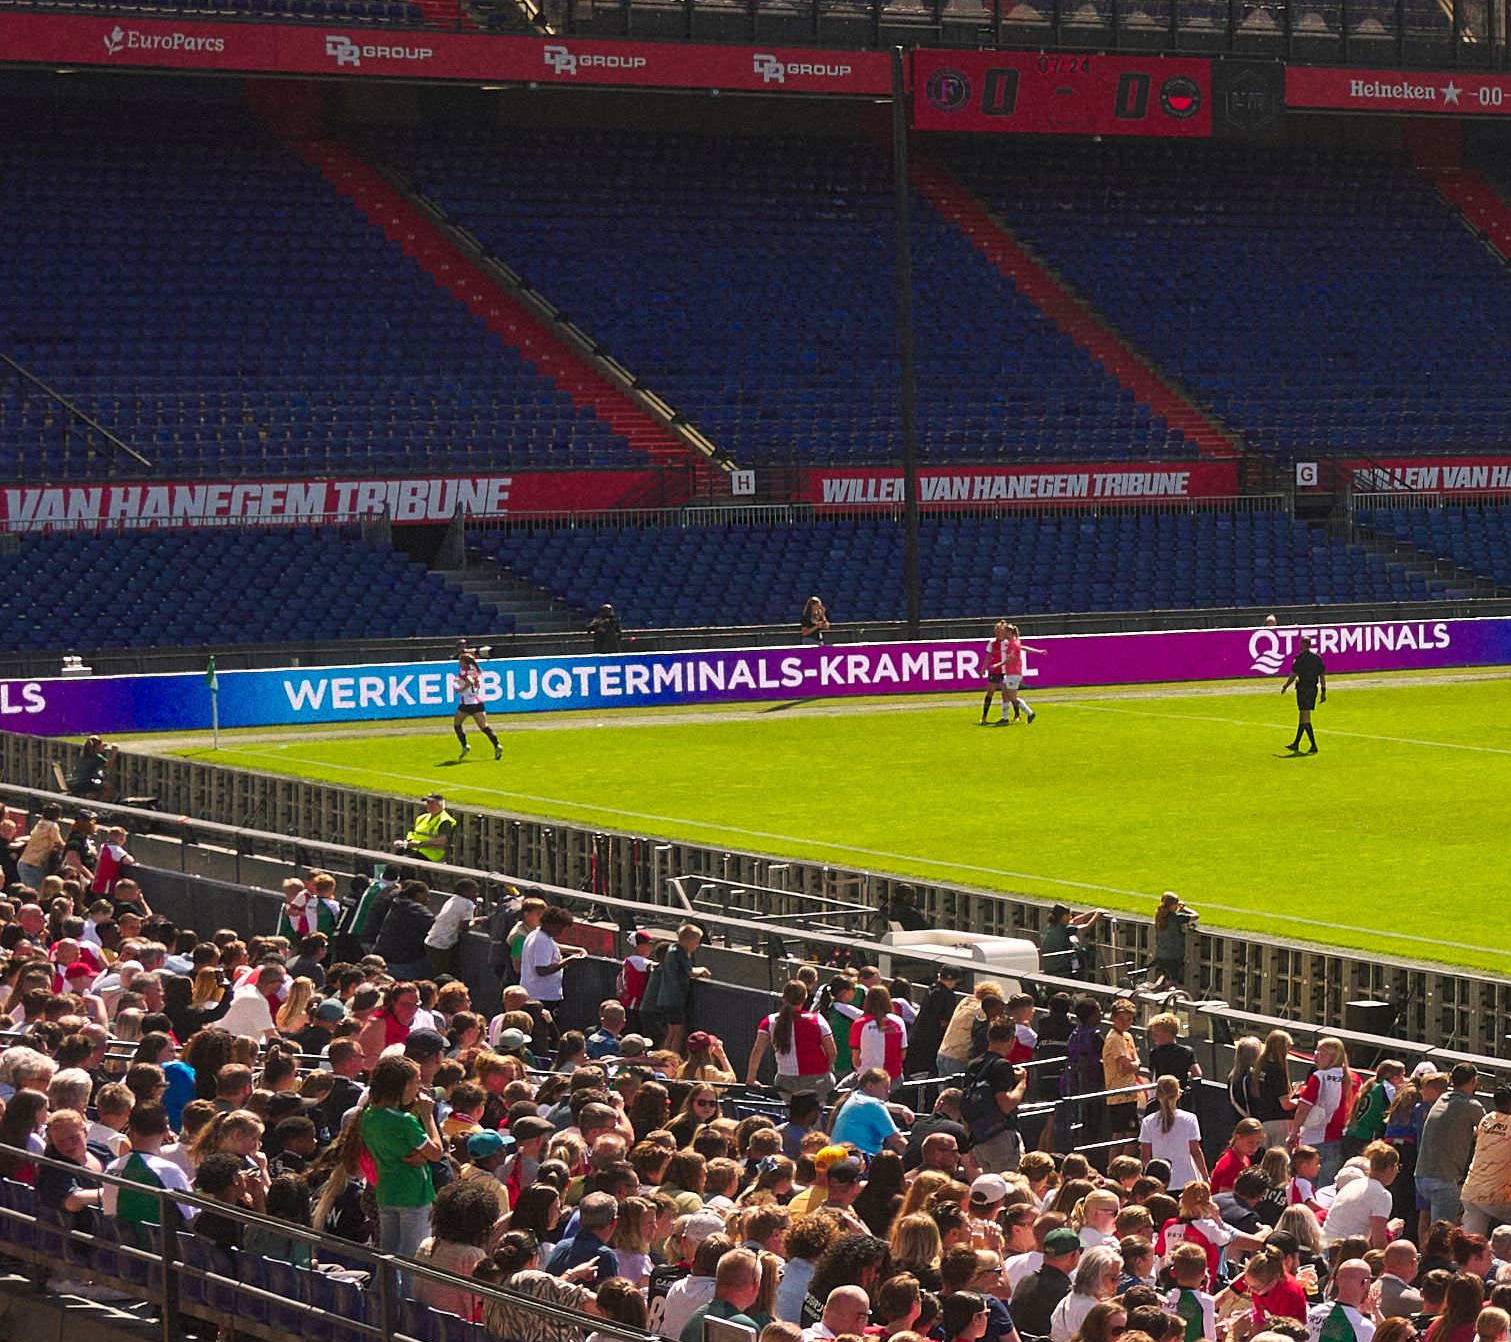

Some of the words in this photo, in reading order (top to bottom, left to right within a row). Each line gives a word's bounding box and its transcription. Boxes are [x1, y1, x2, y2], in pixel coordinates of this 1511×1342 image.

[127, 31, 225, 54] EuroParcs
[362, 45, 433, 59] GROUP
[579, 55, 647, 68] GROUP
[787, 63, 852, 76] GROUP
[1350, 80, 1436, 99] Heineken
[920, 477, 978, 502] VAN
[979, 473, 1088, 500] HANEGEM
[1092, 472, 1190, 497] TRIBUNE
[1441, 466, 1489, 488] VAN
[4, 487, 99, 532] VAN
[104, 482, 328, 529] HANEGEM
[334, 478, 513, 525] TRIBUNE
[284, 645, 1040, 712] WERKENBIJQTERMINALS-KRAMER.L
